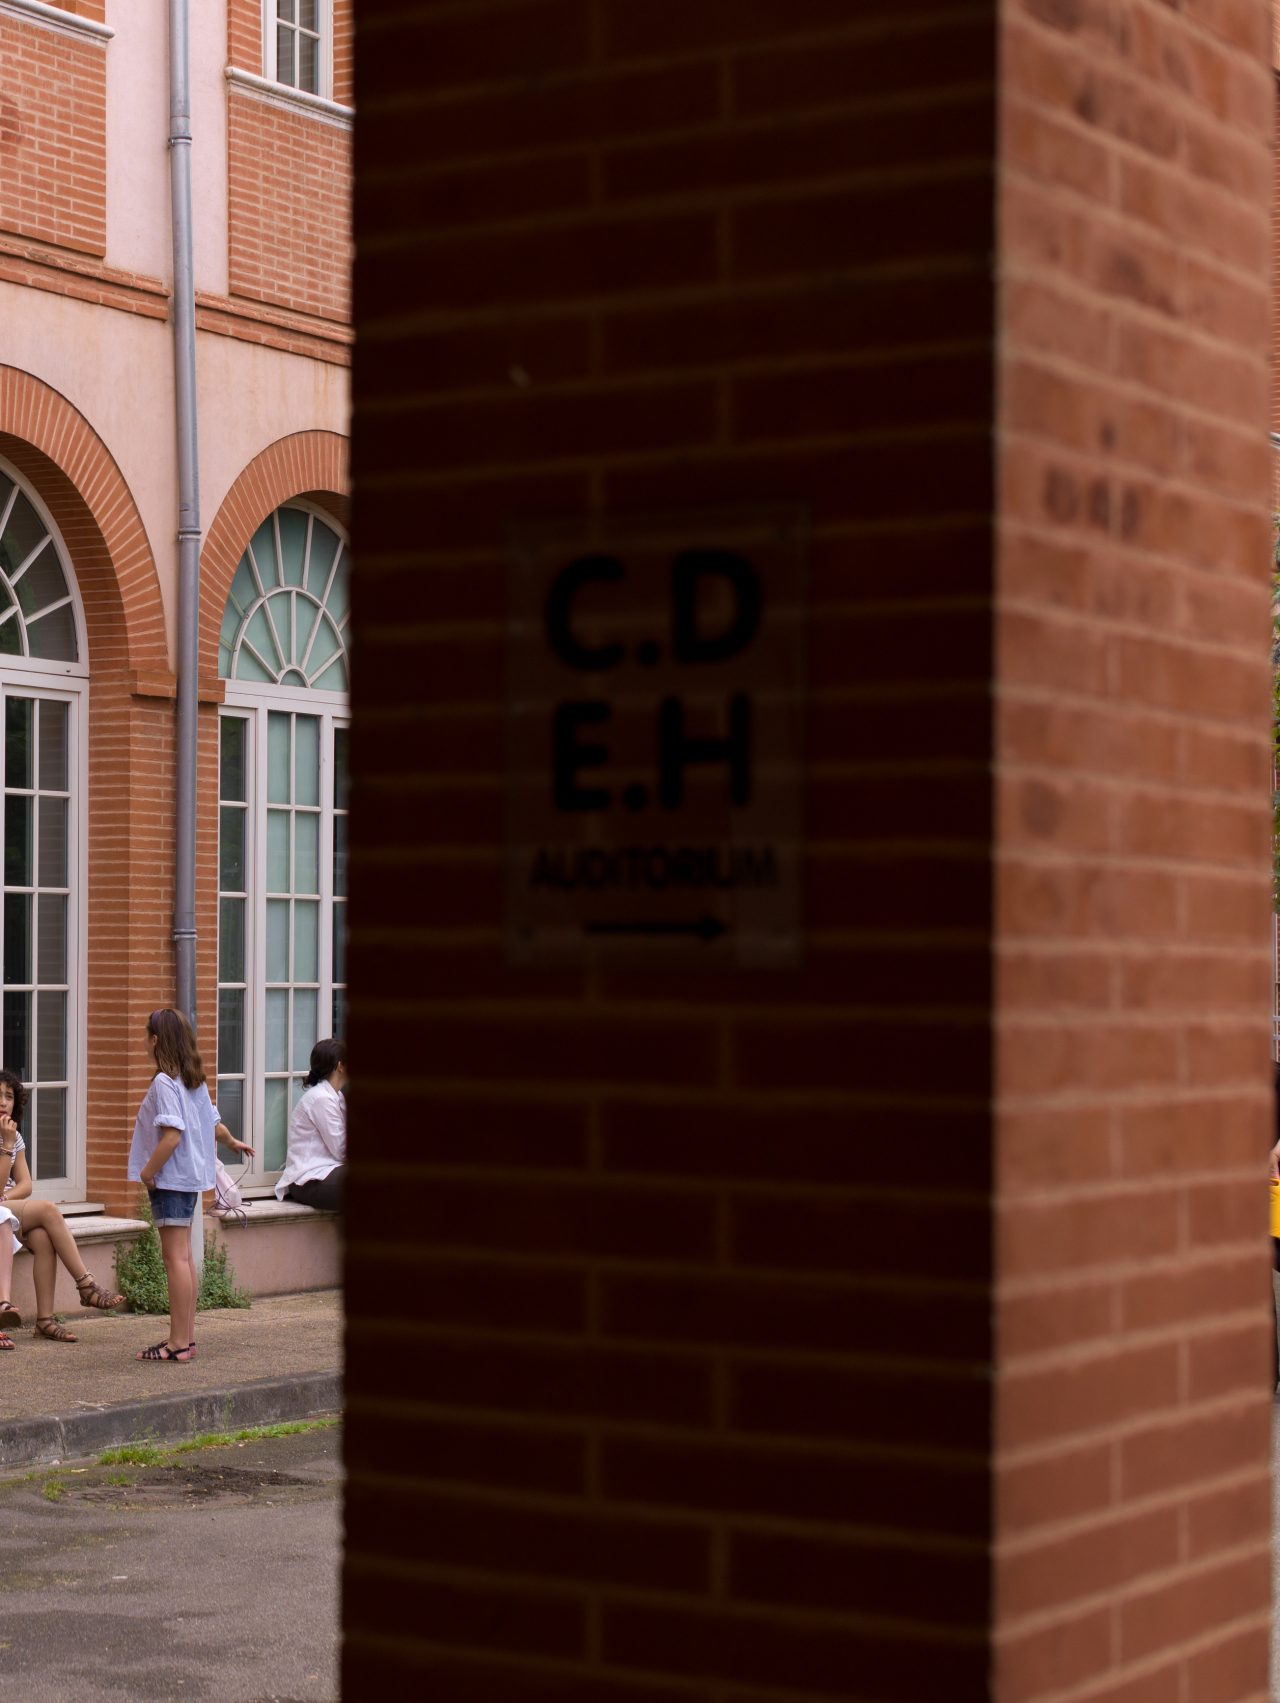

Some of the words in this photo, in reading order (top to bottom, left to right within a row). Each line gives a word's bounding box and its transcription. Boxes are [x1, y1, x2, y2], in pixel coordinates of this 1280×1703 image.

[546, 550, 762, 670] C.D
[553, 692, 752, 812] E.H
[531, 845, 778, 889] AUDITORIUM
